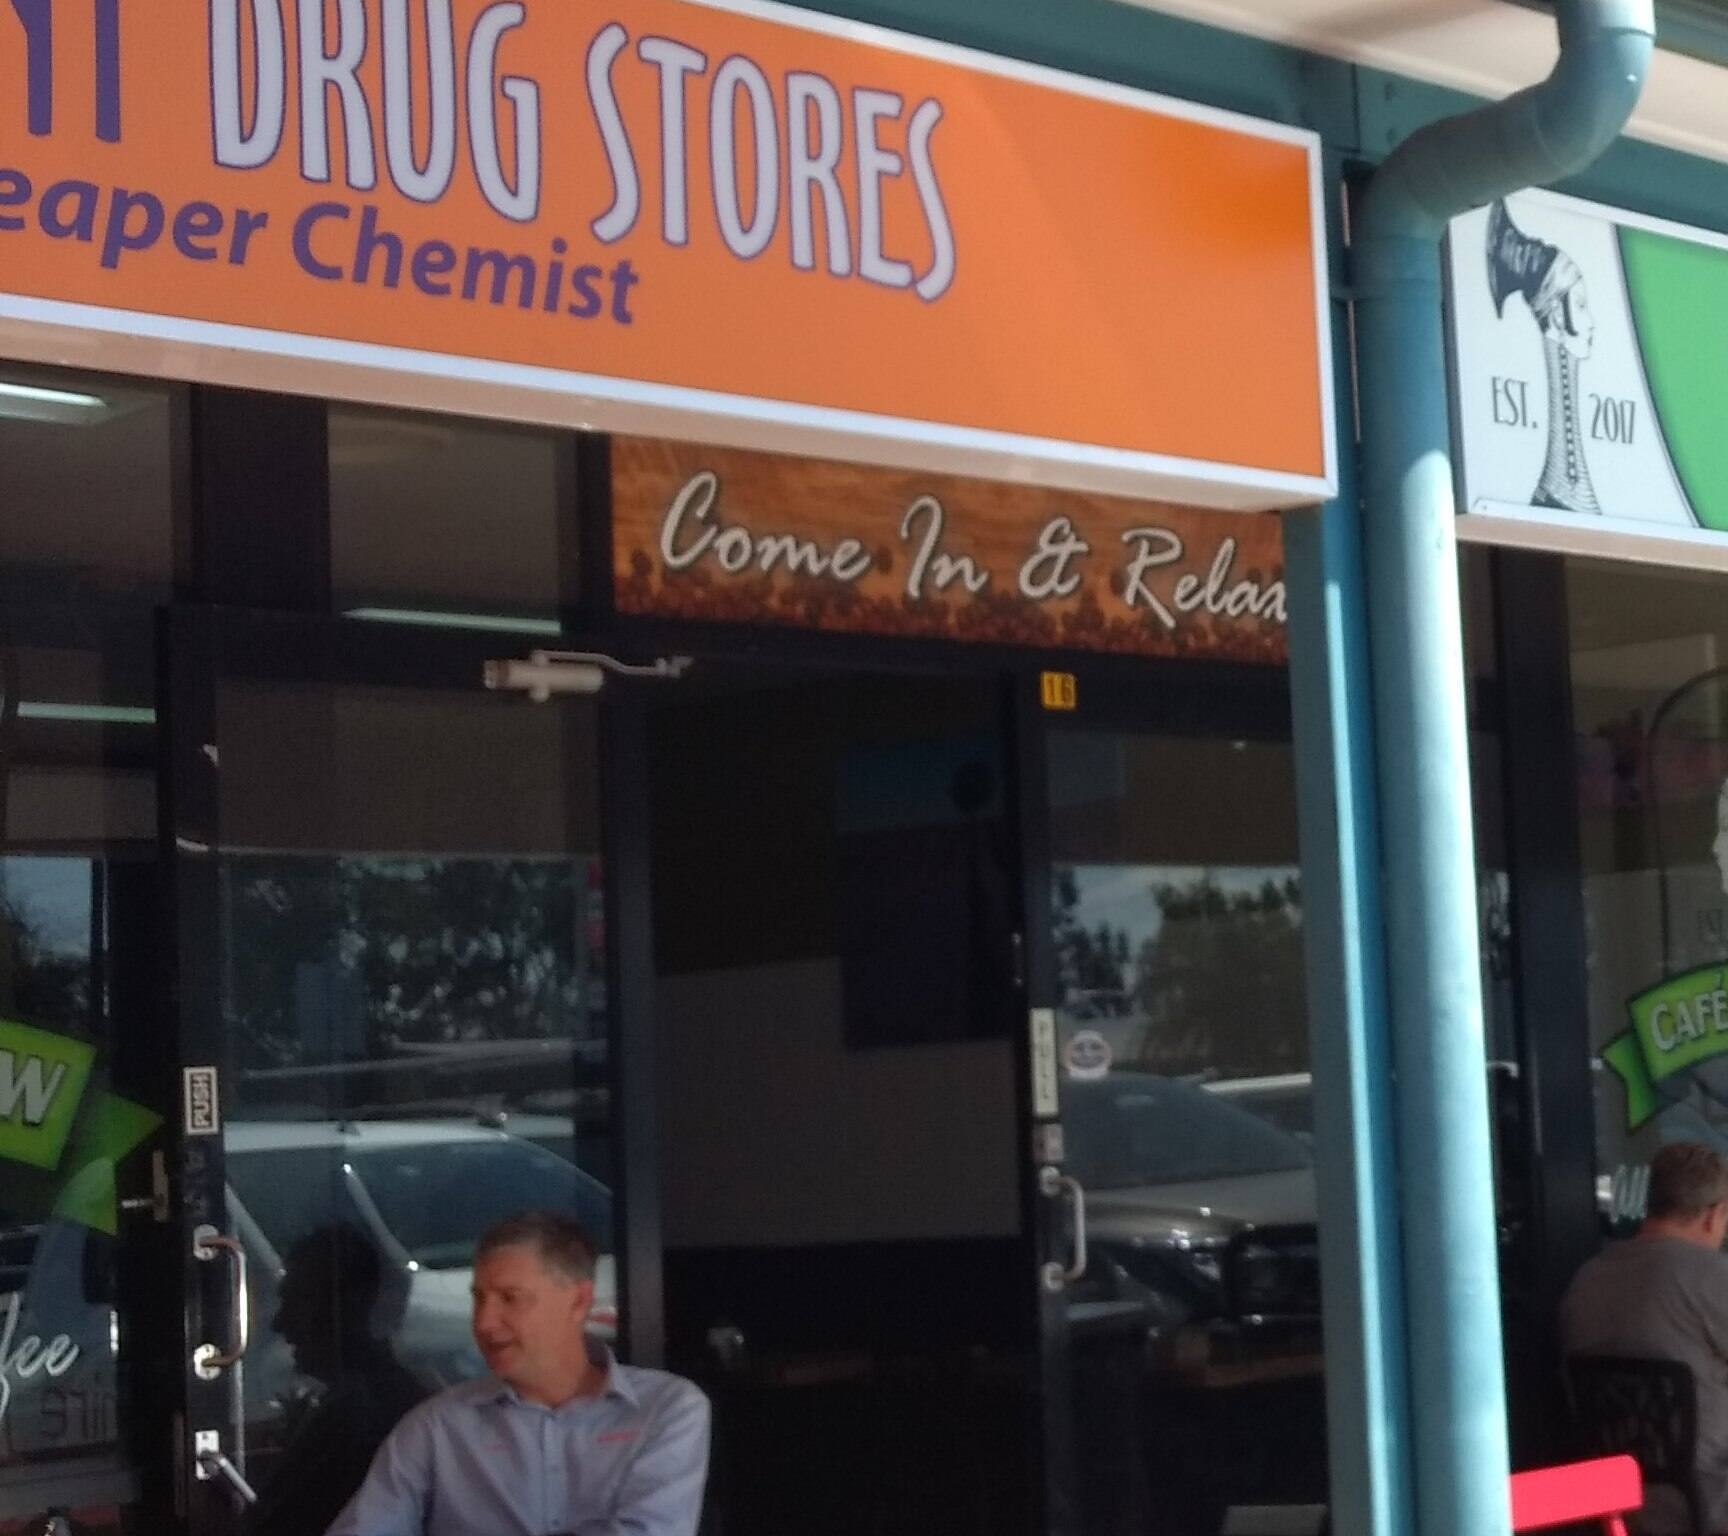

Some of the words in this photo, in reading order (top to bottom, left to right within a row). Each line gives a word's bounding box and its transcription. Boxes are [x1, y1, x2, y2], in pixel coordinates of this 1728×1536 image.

[586, 21, 956, 304] STORES
[0, 168, 270, 269] eaper
[290, 201, 641, 326] Chemist
[1491, 375, 1538, 431] EST.
[1589, 393, 1638, 447] 2017
[659, 470, 872, 582] Come
[899, 494, 988, 602] In
[1018, 516, 1090, 601] &
[193, 1071, 212, 1128] PUSH
